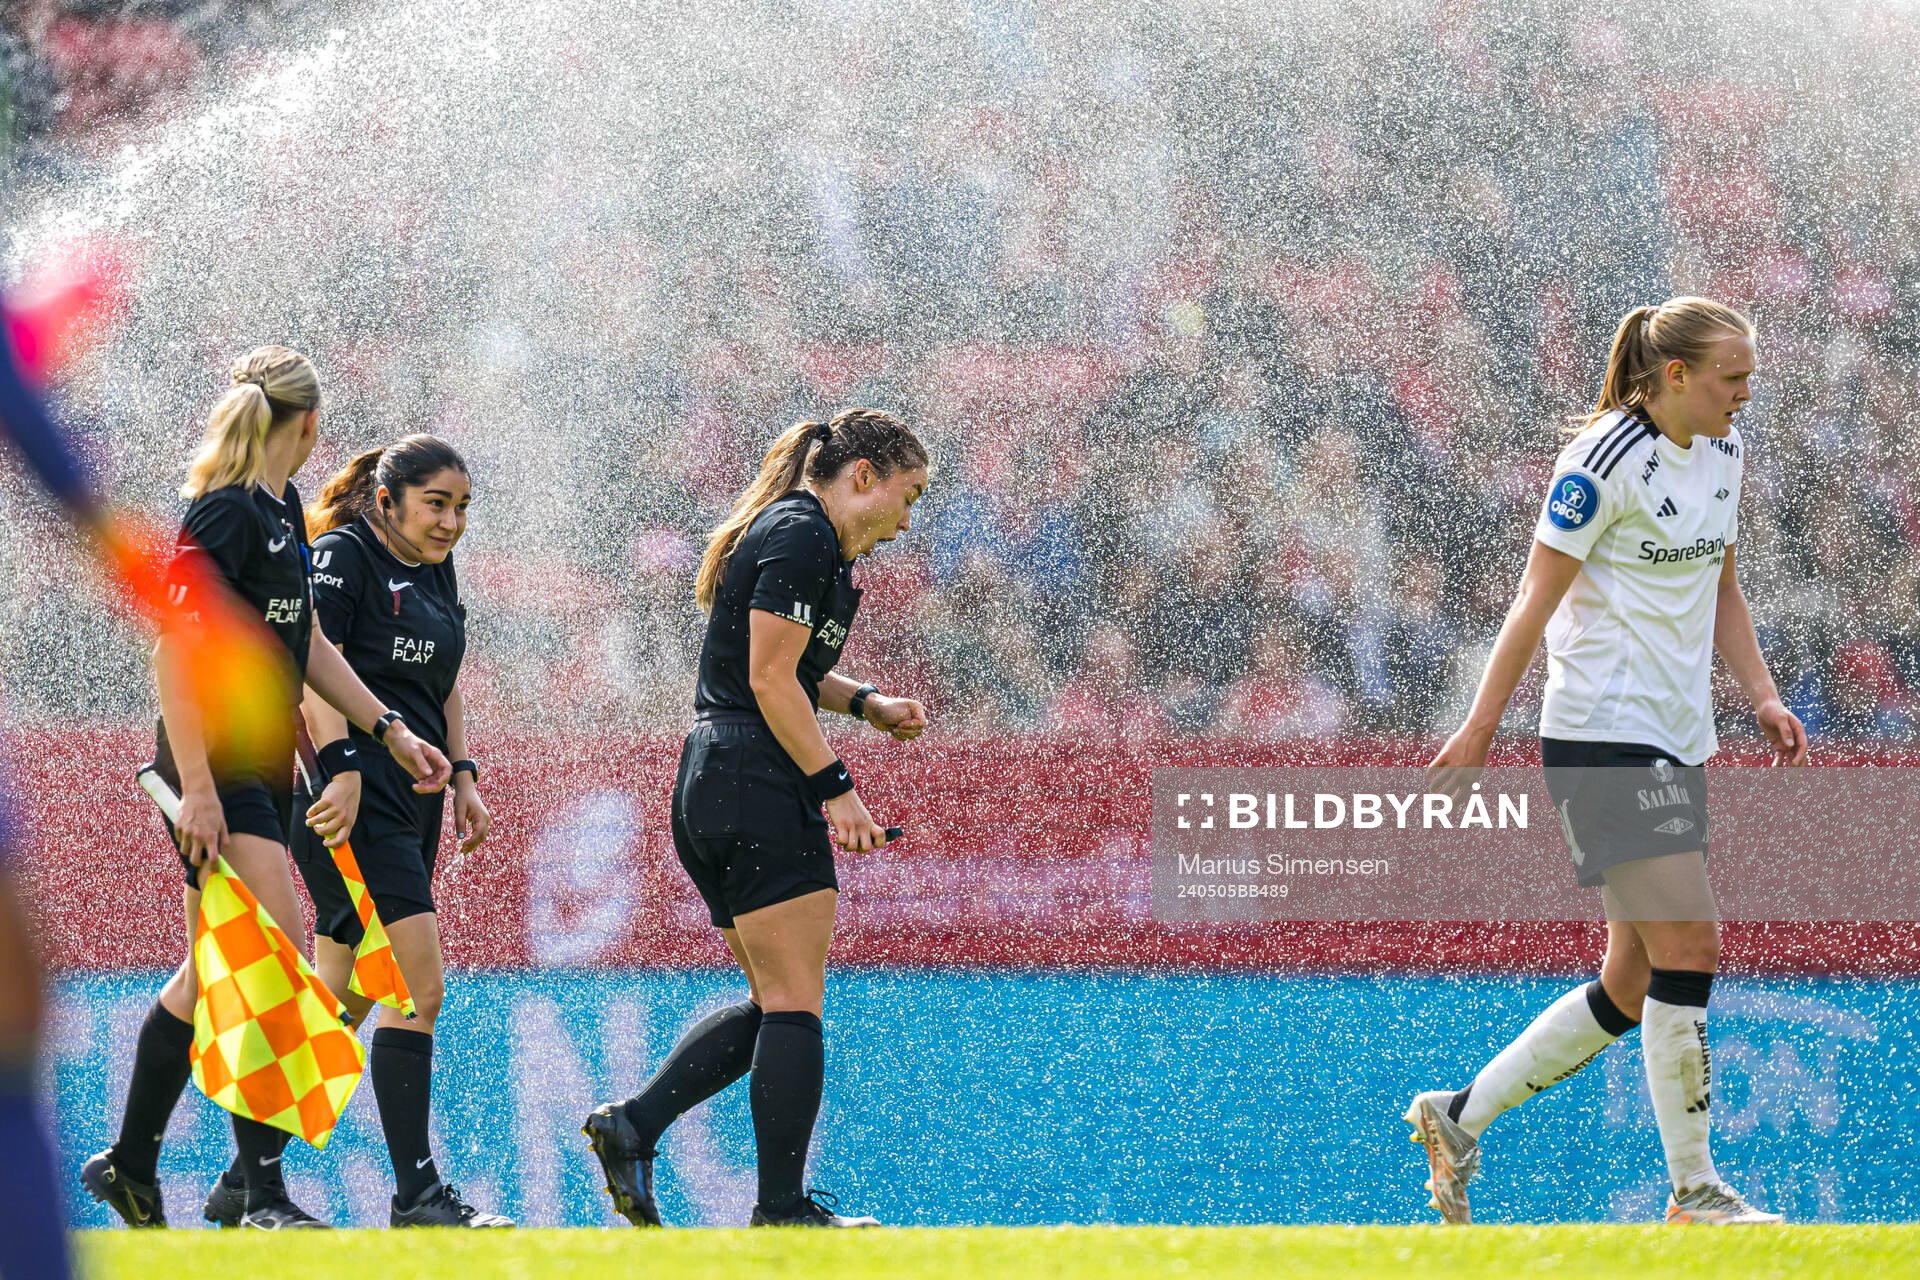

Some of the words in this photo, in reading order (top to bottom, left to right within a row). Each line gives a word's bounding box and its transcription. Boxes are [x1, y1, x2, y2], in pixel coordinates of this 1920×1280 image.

[1710, 437, 1740, 459] HENT
[1551, 500, 1584, 524] OBOS
[268, 598, 302, 610] FAIR
[265, 611, 301, 624] PLAY
[824, 619, 847, 640] FAIR
[394, 636, 435, 653] FAIR
[816, 629, 843, 650] PLAY
[392, 649, 433, 664] PLAY
